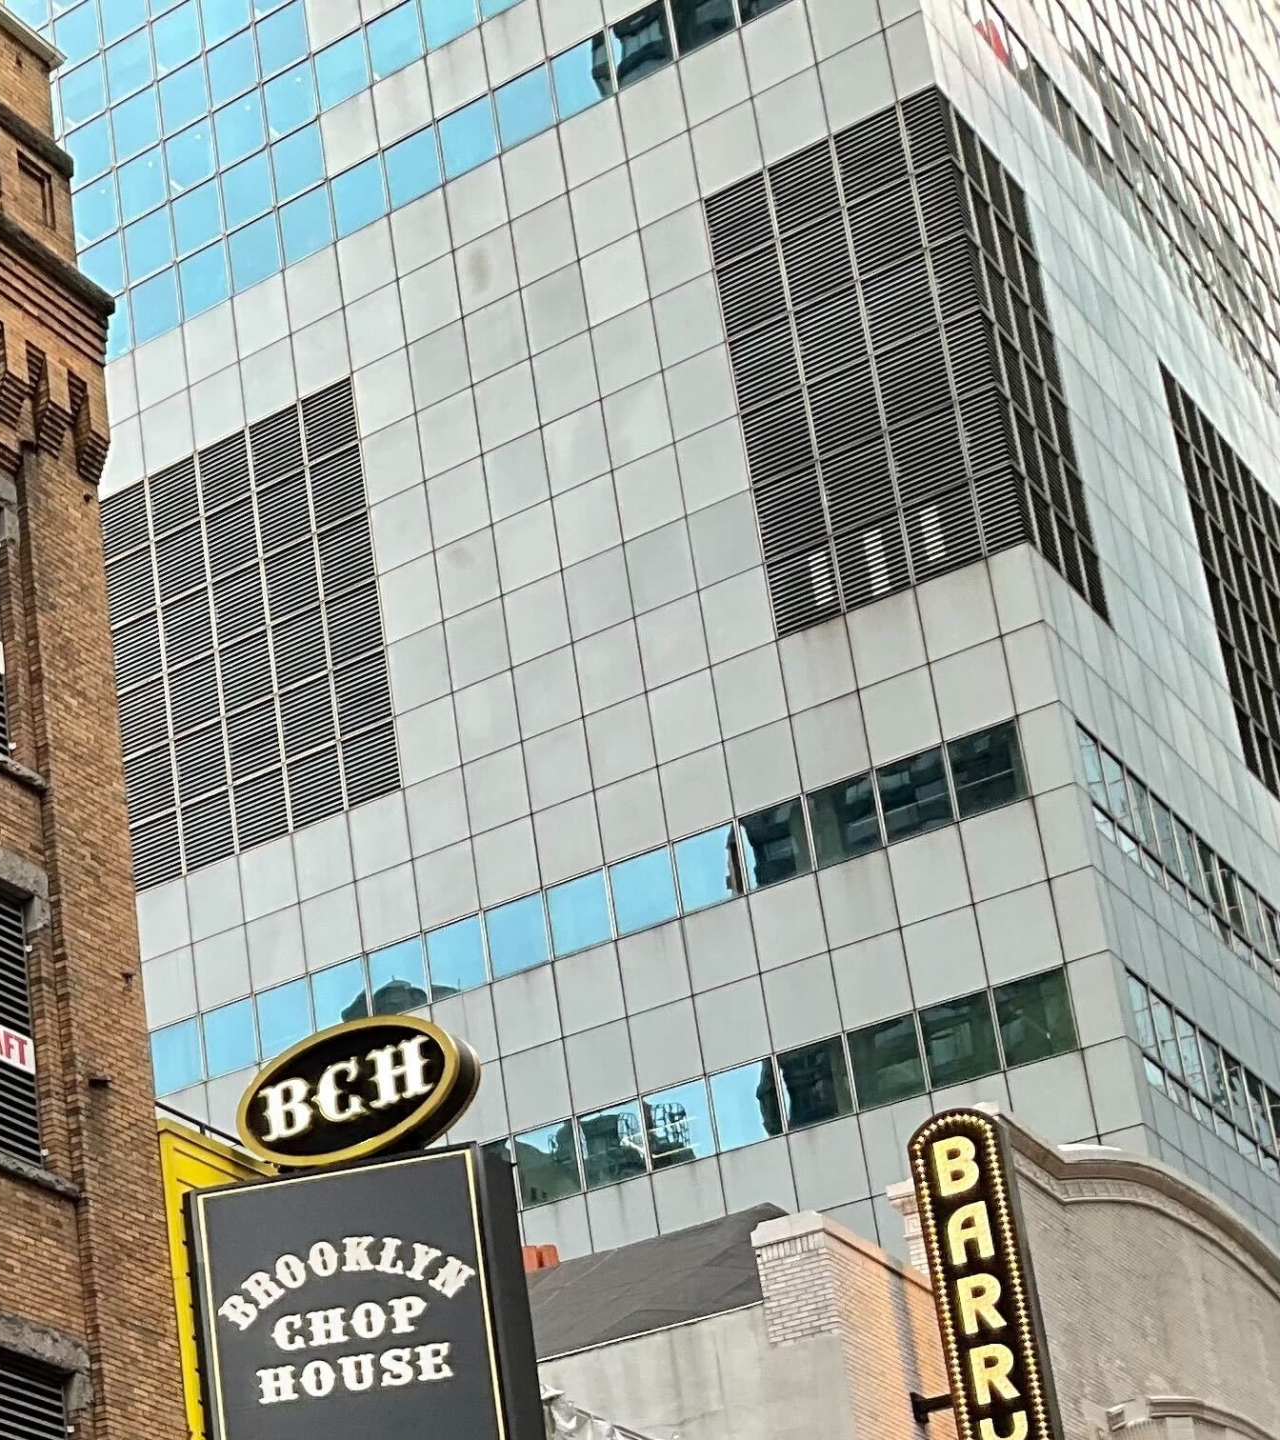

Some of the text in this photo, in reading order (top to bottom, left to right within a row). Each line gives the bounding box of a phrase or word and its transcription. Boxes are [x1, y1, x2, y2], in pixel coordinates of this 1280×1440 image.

[258, 1034, 433, 1143] BCH
[218, 1235, 475, 1331] BROOKLYN
[271, 1296, 427, 1351] CHOP
[256, 1342, 454, 1404] HOUSE
